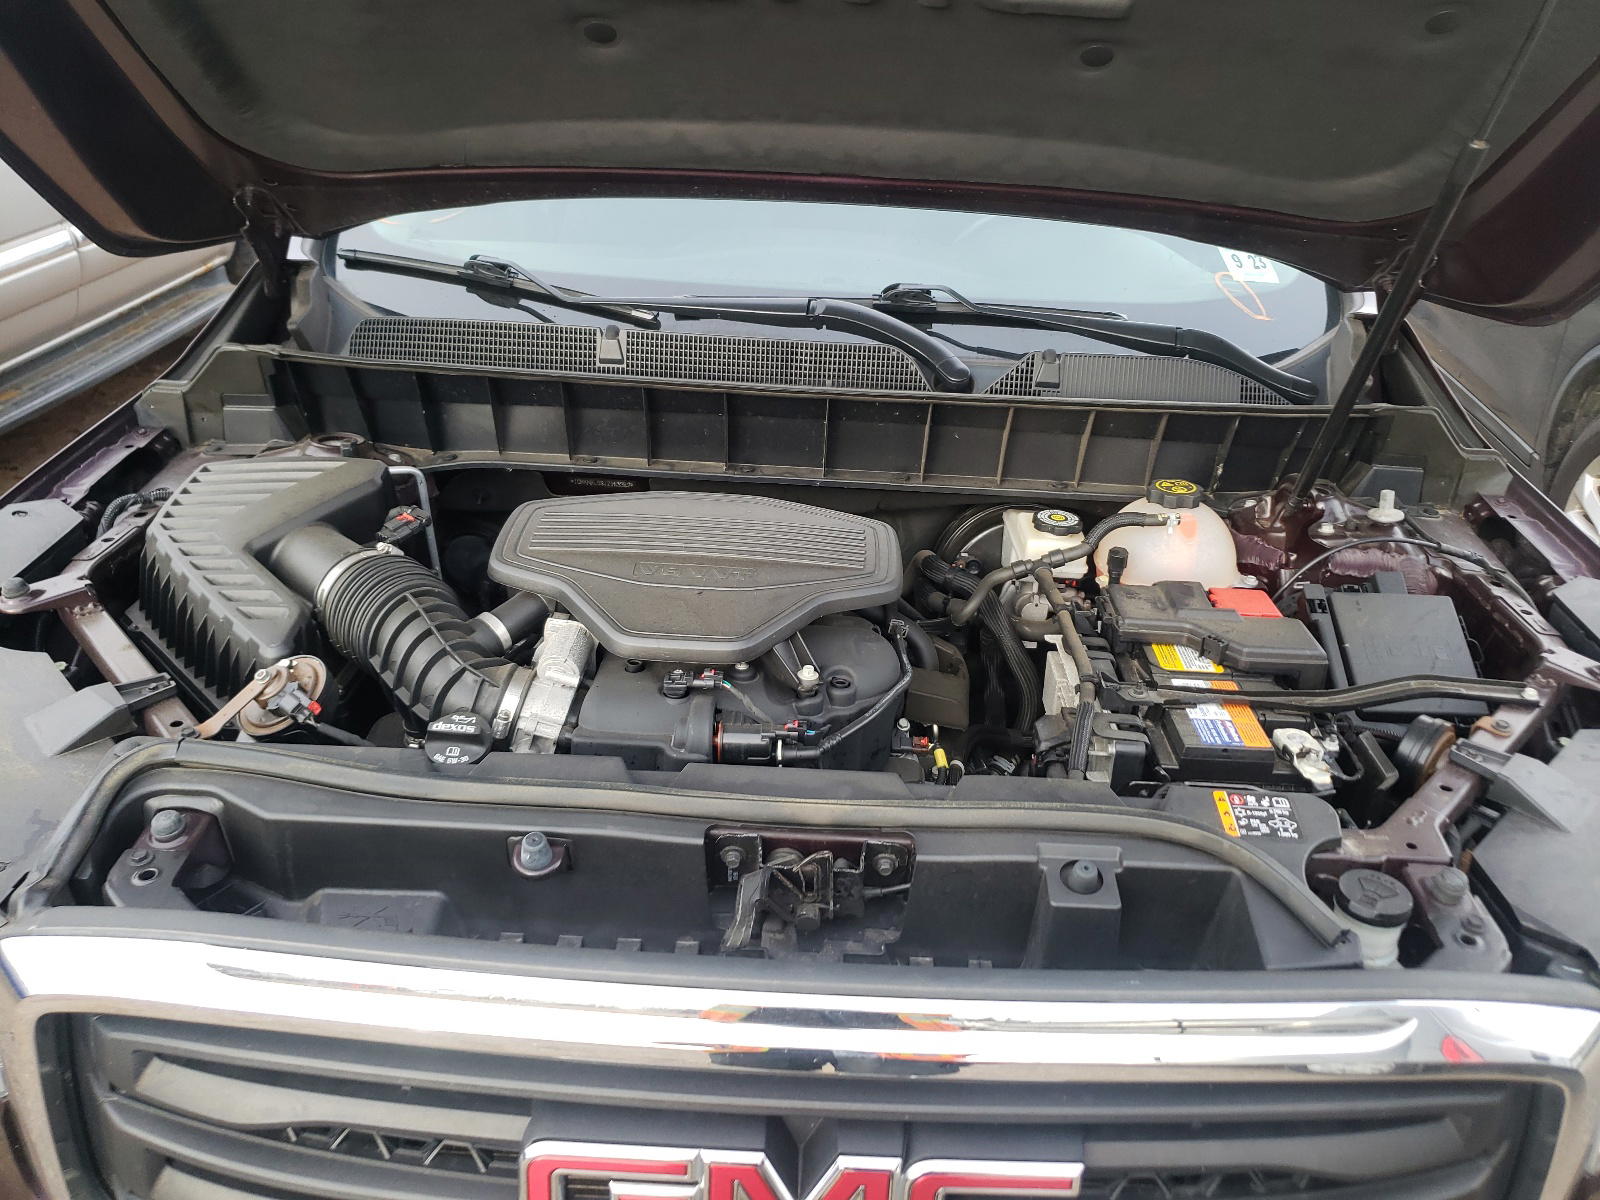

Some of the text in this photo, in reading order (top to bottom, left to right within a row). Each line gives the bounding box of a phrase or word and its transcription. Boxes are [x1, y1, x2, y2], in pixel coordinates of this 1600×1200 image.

[1231, 253, 1243, 268] 9
[432, 722, 477, 733] dexos
[446, 756, 470, 765] 5W-30
